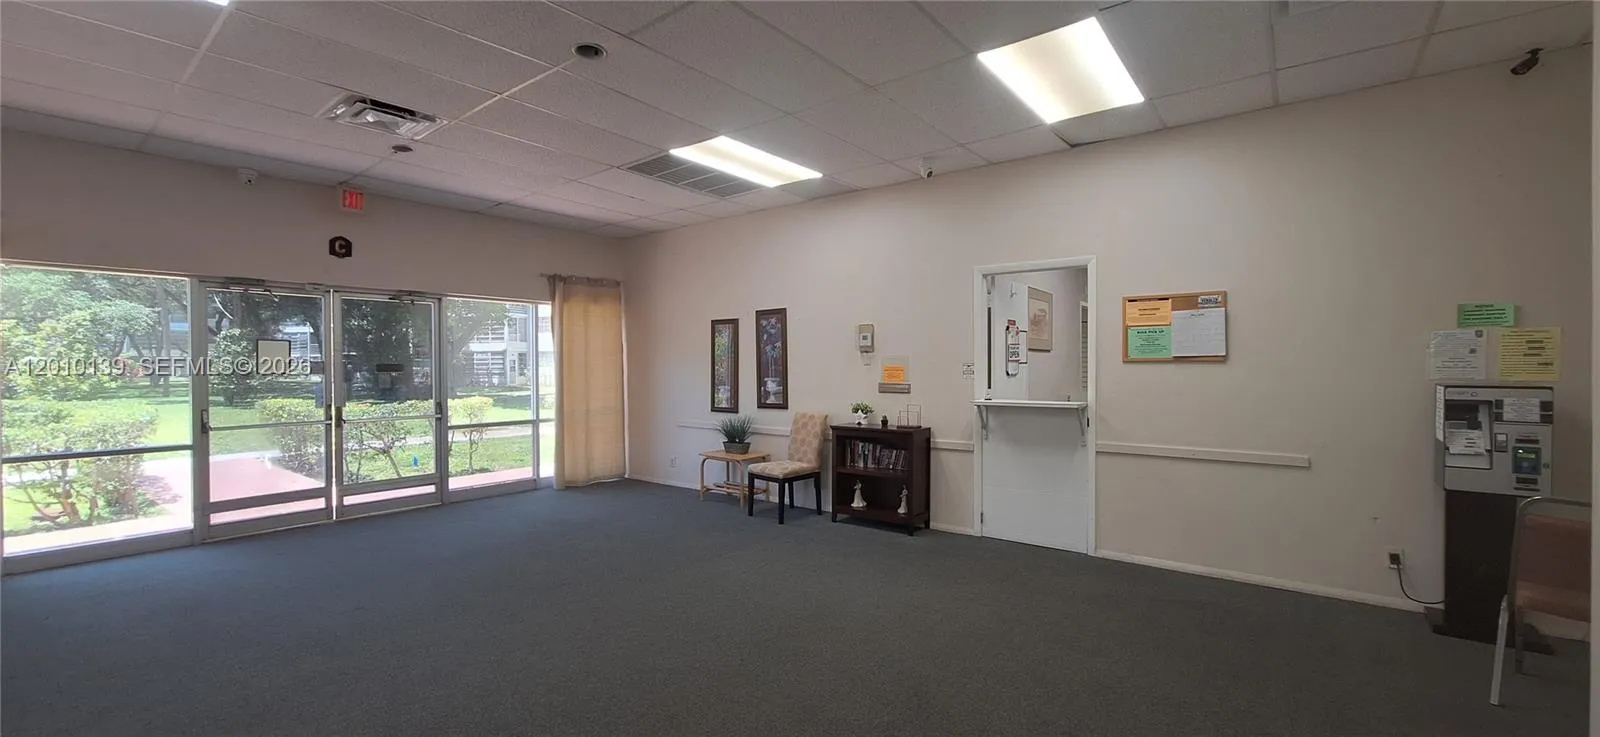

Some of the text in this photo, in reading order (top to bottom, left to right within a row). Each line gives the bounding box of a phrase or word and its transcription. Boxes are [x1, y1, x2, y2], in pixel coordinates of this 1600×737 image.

[343, 190, 364, 211] EXIT
[336, 240, 346, 253] C
[1010, 350, 1019, 358] OPEN
